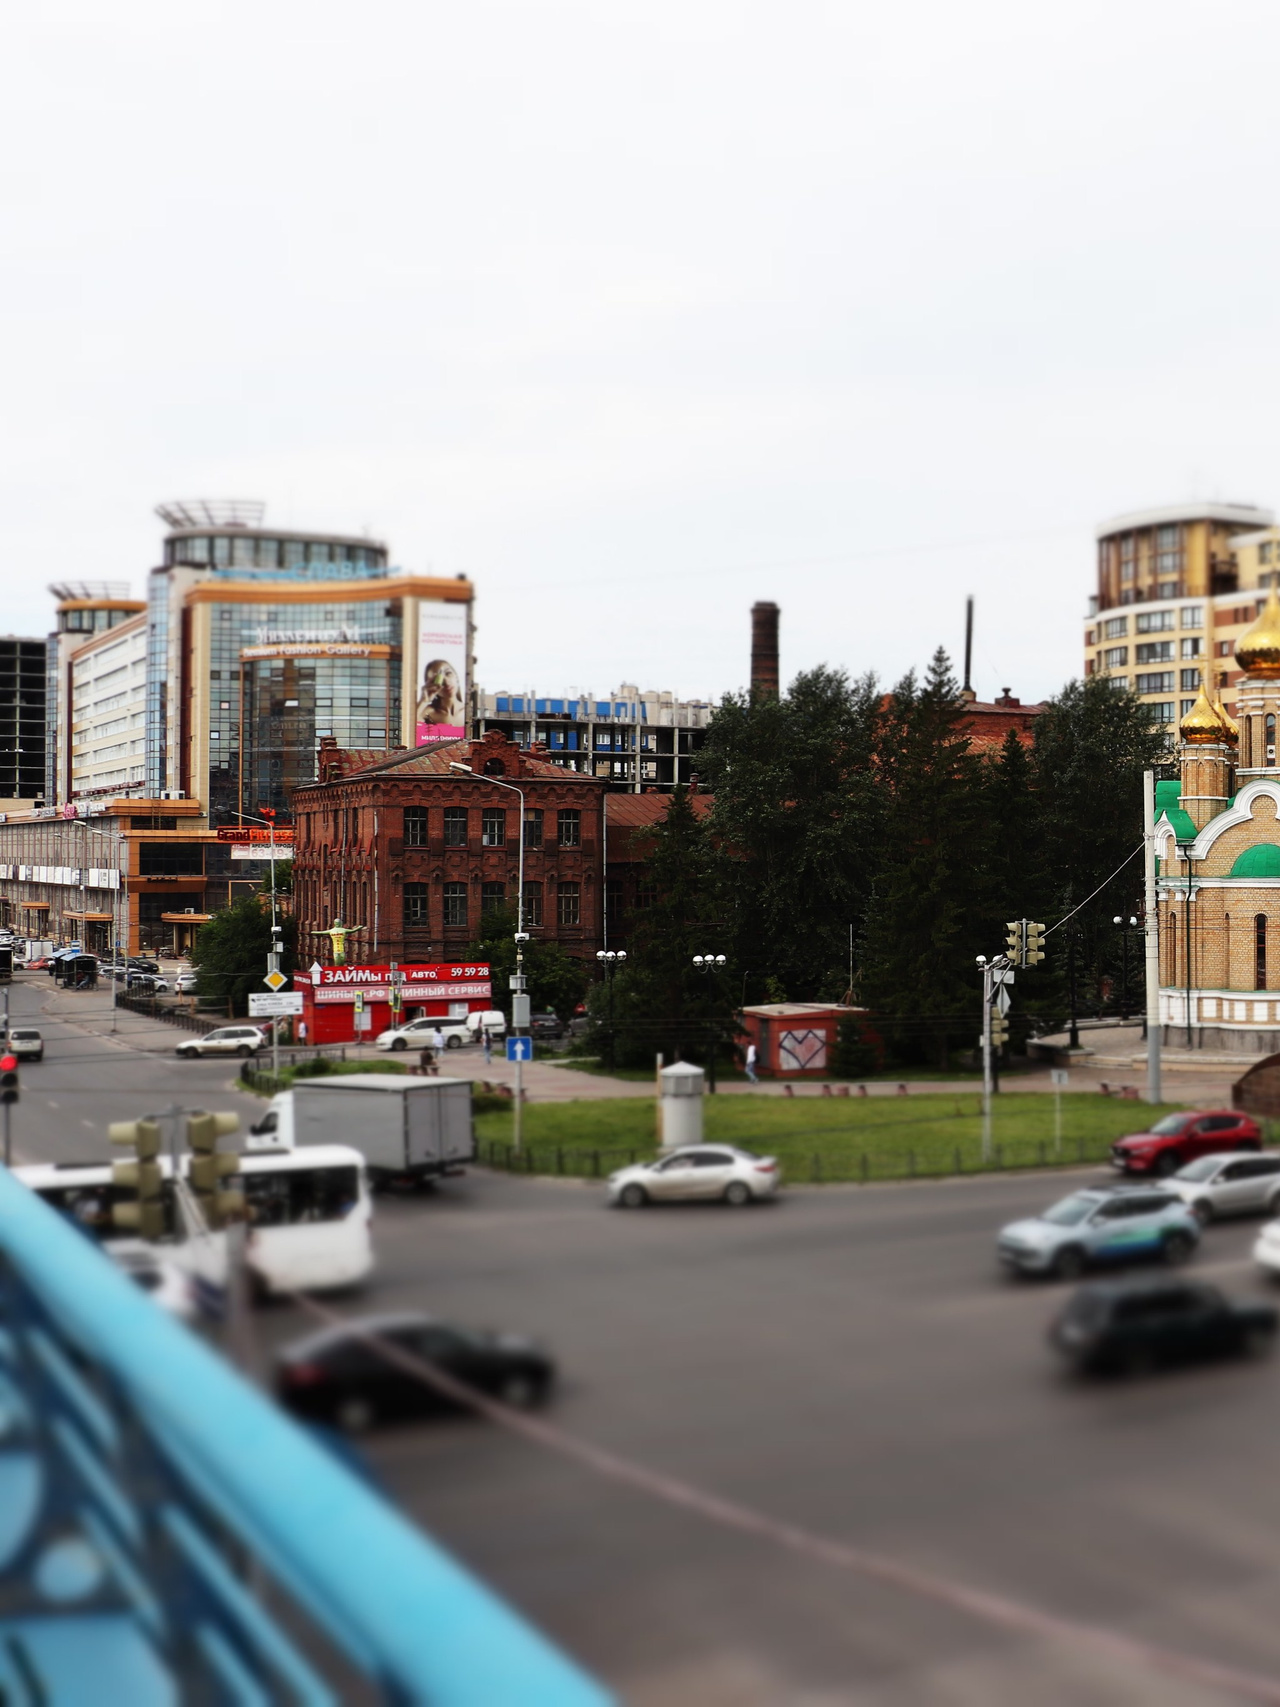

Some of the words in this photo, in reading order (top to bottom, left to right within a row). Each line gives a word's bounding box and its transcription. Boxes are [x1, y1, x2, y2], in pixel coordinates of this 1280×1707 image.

[293, 562, 369, 581] СЛАВА
[325, 644, 370, 656] Gallery
[451, 967, 463, 977] 59
[464, 966, 476, 976] 59
[477, 966, 490, 976] 28
[448, 984, 490, 996] СЕРВИС
